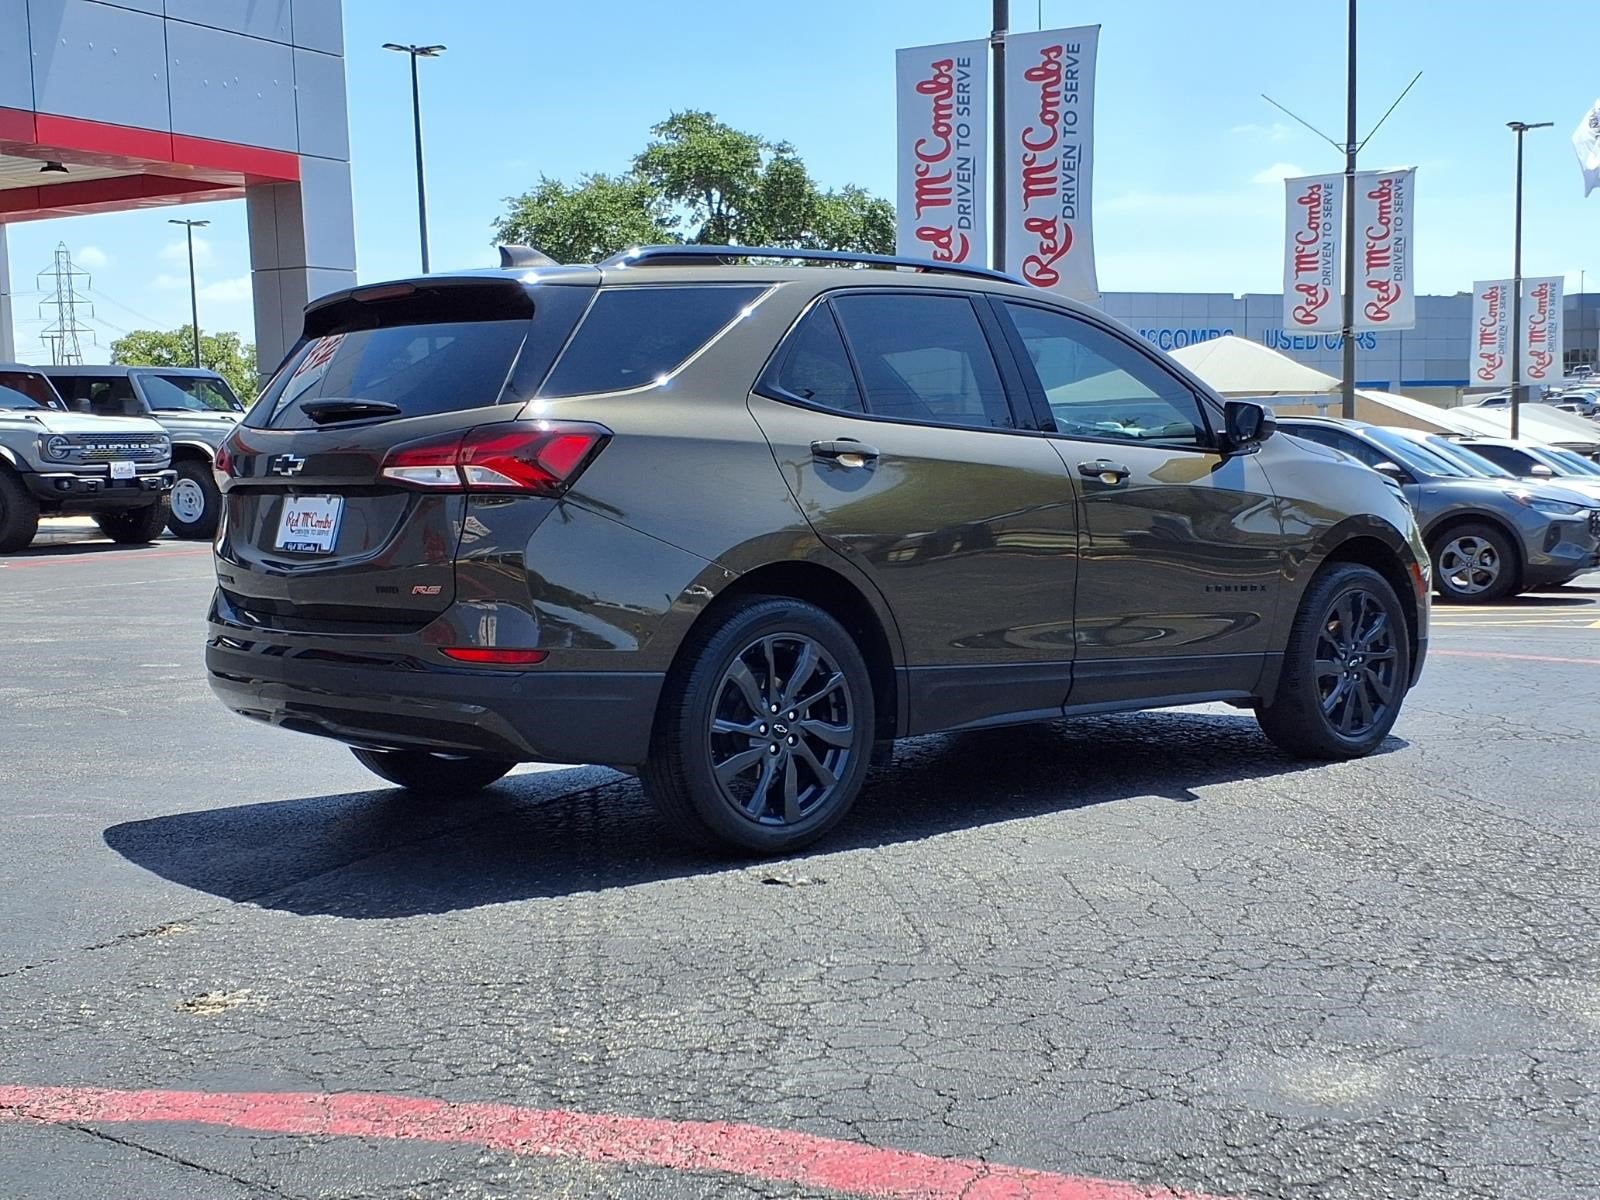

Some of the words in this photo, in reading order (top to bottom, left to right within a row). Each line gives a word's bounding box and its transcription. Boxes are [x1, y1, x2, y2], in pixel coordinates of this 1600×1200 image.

[957, 56, 972, 121] SERVE
[1065, 43, 1081, 104] SERVE
[914, 58, 954, 220] McCombs
[957, 123, 972, 150] TO
[1021, 44, 1064, 212] McCombs
[1063, 111, 1078, 138] TO
[957, 156, 972, 229] DRIVEN
[1062, 144, 1077, 220] DRIVEN
[1394, 177, 1405, 213] SERVE
[1323, 183, 1333, 218] SERVE
[1295, 184, 1322, 280] McCombs
[1323, 222, 1332, 238] TO
[1365, 179, 1393, 277] McCombs
[1394, 218, 1403, 233] TO
[1022, 214, 1073, 288] Red
[1322, 242, 1332, 286] DRIVEN
[1393, 237, 1403, 281] DRIVEN
[1293, 283, 1329, 325] Red
[1364, 279, 1401, 321] Red
[1499, 285, 1507, 309] SERVE
[1549, 282, 1557, 307] SERVE
[1479, 285, 1499, 350] McCombs
[1498, 312, 1506, 322] TO
[1528, 282, 1548, 347] McCombs
[1548, 309, 1555, 320] TO
[1265, 329, 1319, 350] USED
[1497, 325, 1506, 355] DRIVEN
[1547, 323, 1555, 353] DRIVEN
[1477, 352, 1503, 381] Red
[1527, 350, 1553, 379] Red
[286, 510, 301, 533] Red
[301, 511, 333, 529] McCombs
[411, 585, 442, 595] RS
